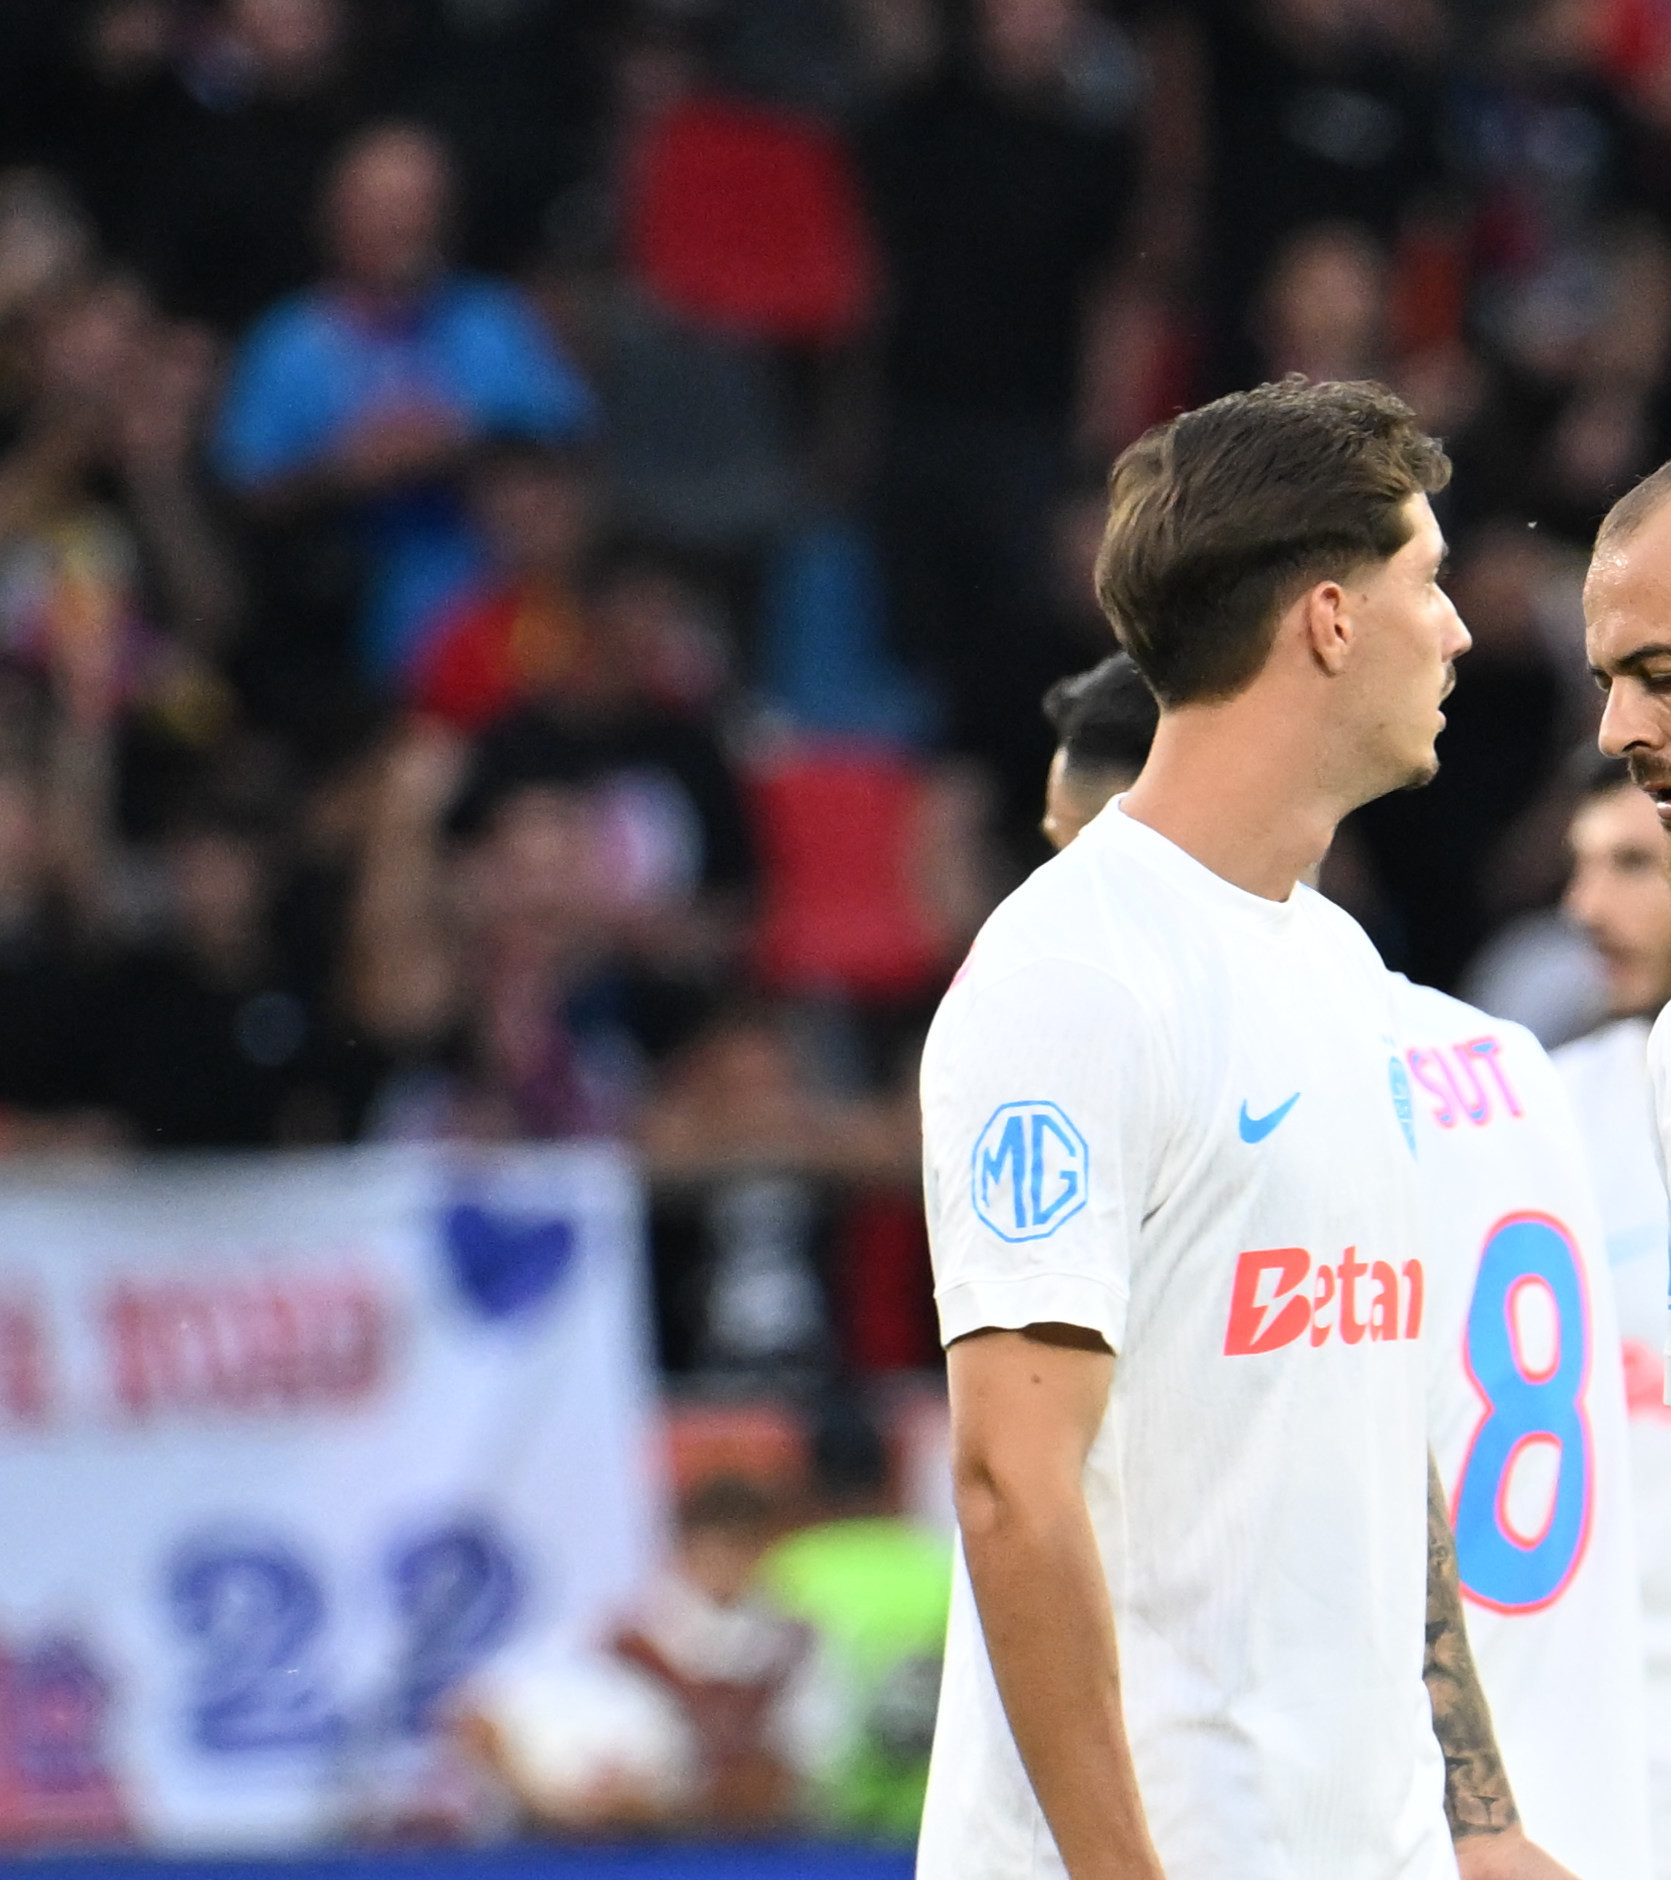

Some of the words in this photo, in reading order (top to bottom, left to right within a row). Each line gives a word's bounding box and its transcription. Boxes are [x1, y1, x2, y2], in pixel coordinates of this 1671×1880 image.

[981, 1113, 1079, 1229] MG
[1222, 1244, 1425, 1358] Betan
[1451, 1209, 1594, 1616] 8
